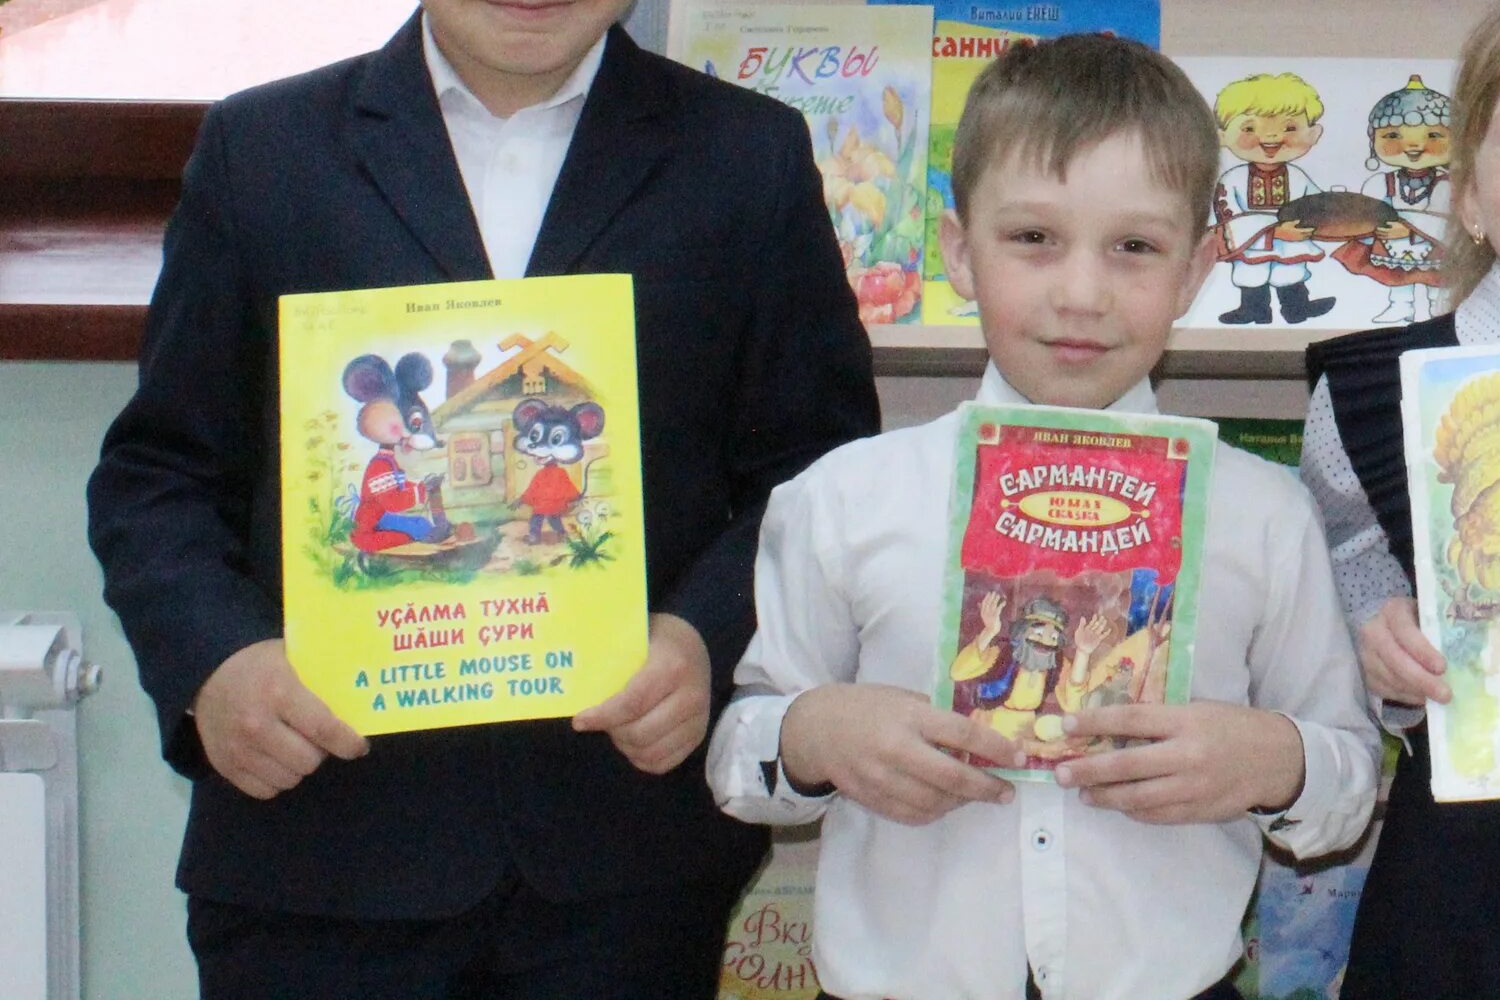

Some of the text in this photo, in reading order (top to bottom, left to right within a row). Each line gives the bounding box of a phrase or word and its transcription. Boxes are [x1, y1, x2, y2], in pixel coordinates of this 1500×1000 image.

[738, 46, 879, 86] БУКВЫ
[406, 299, 502, 313] Иван Яковлев
[1033, 432, 1132, 448] ИВАН ЯКОВЛЕВ
[1047, 509, 1101, 521] СКАЗКА
[355, 650, 574, 687] A LITTLE MOUSE ON
[372, 676, 564, 711] A WALKING TOUR
